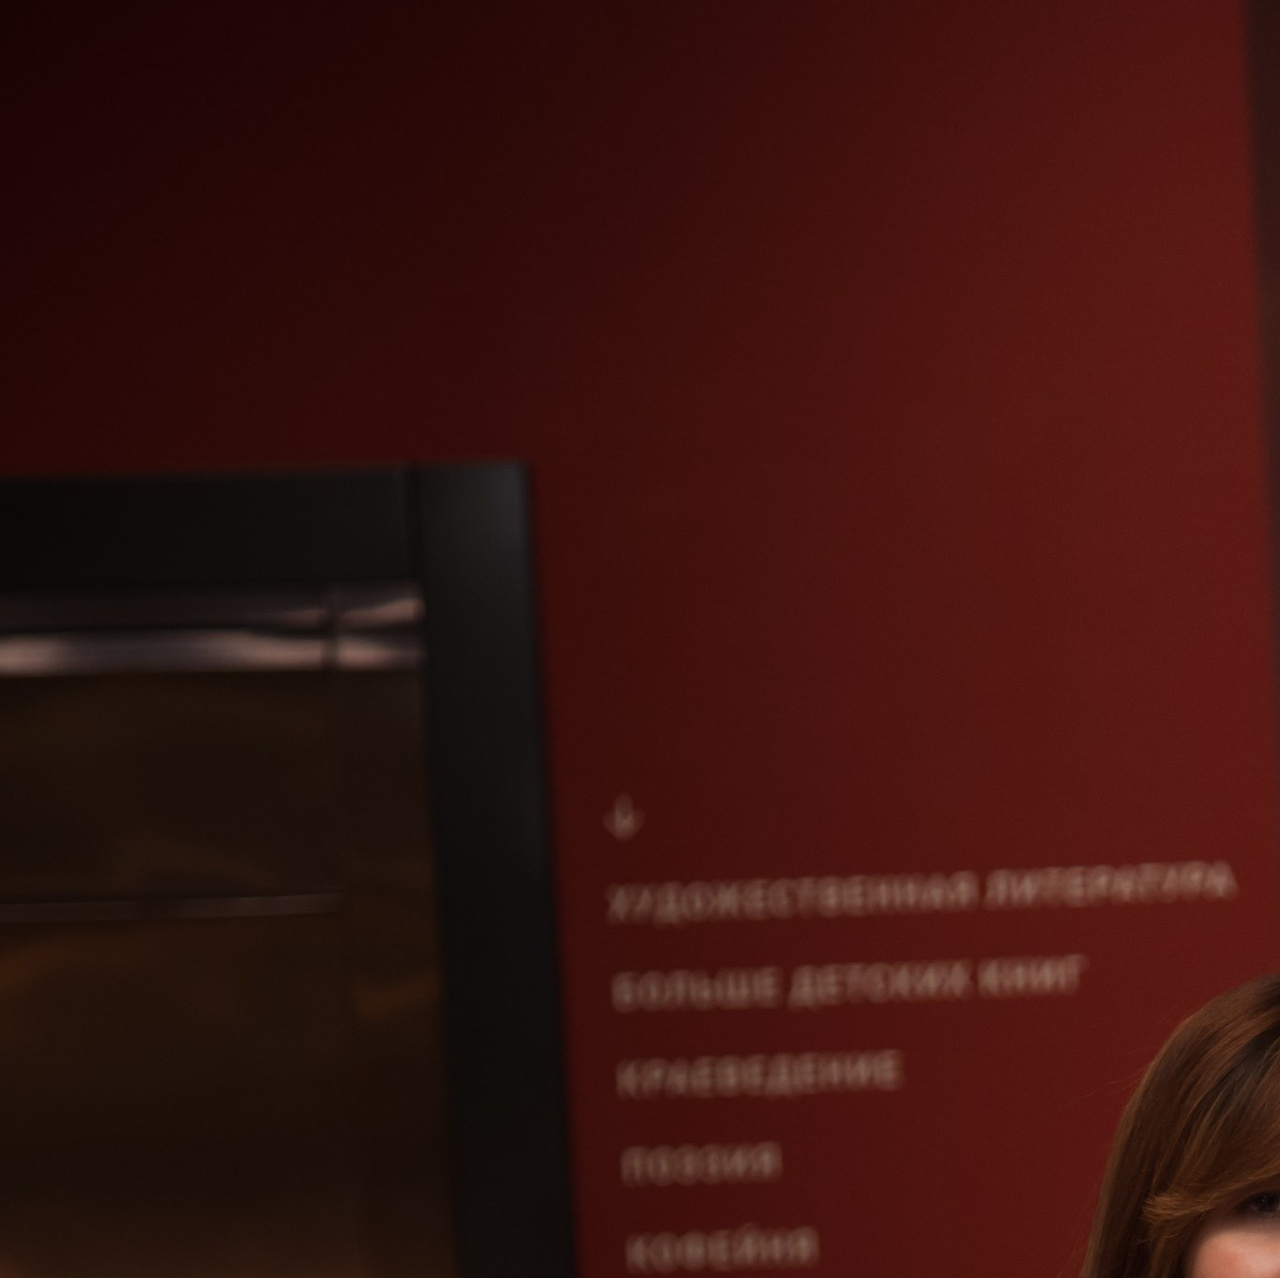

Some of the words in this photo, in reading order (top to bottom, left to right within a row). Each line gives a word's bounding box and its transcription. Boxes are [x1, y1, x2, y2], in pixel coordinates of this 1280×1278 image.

[607, 871, 980, 926] ХУДОЖЕСТВЕННАЯ
[985, 861, 1239, 910] ЛИТЕРАТУРА
[610, 966, 781, 1013] БОЛЬШЕ
[788, 960, 974, 1010] ДЕТСКИХ
[978, 953, 1088, 998] КНИГ
[616, 1049, 904, 1099] КРАЕВЕДЕНИЕ
[621, 1141, 783, 1186] ПОЭЗИЯ
[626, 1223, 820, 1272] КОФЕЙНЯ
